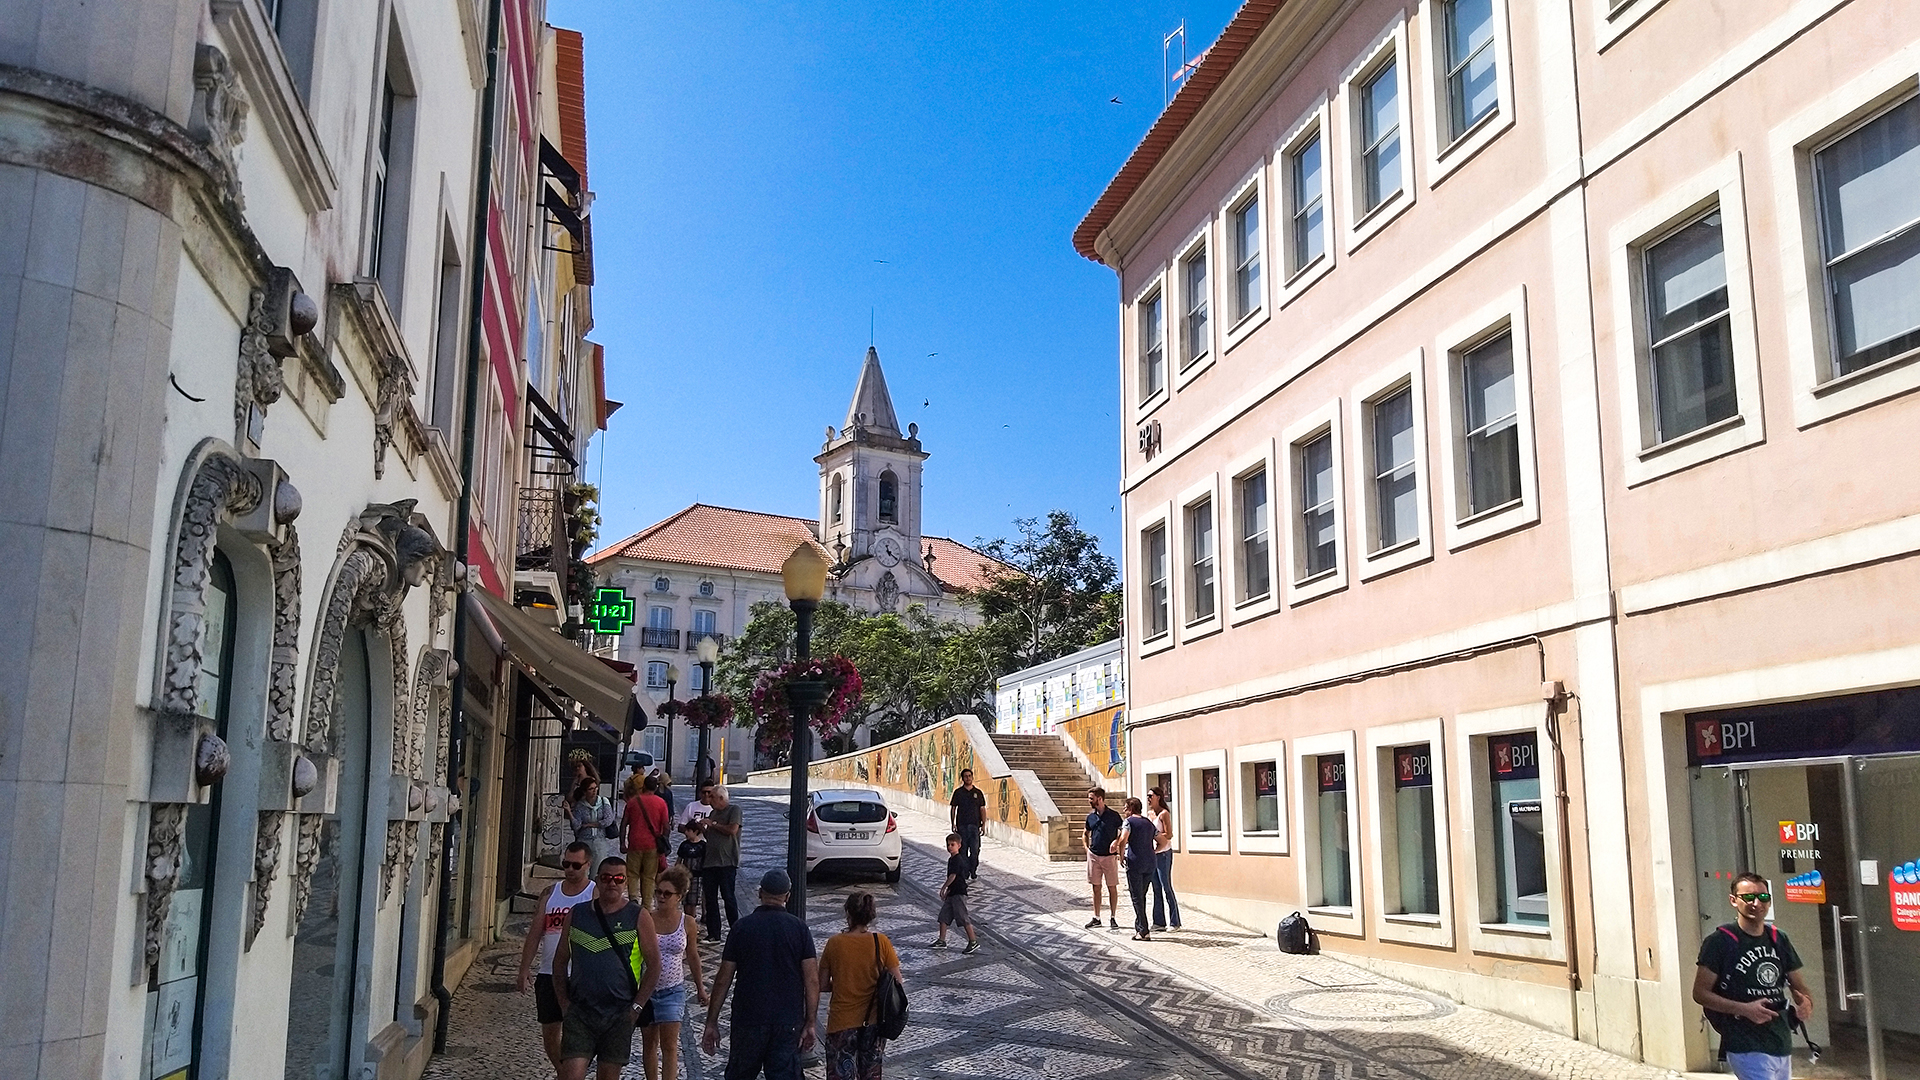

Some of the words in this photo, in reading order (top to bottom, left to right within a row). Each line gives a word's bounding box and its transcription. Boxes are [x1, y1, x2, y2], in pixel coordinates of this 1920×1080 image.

[1139, 420, 1159, 453] BPI
[1721, 721, 1756, 749] BPI
[1412, 755, 1431, 776] BPI
[1512, 745, 1535, 768] BPI
[1333, 764, 1345, 782] BP
[694, 811, 711, 819] FIL
[1796, 823, 1820, 841] BPI
[1781, 849, 1822, 860] PREMIER
[551, 907, 571, 916] JAC
[1735, 945, 1781, 975] PORTLA
